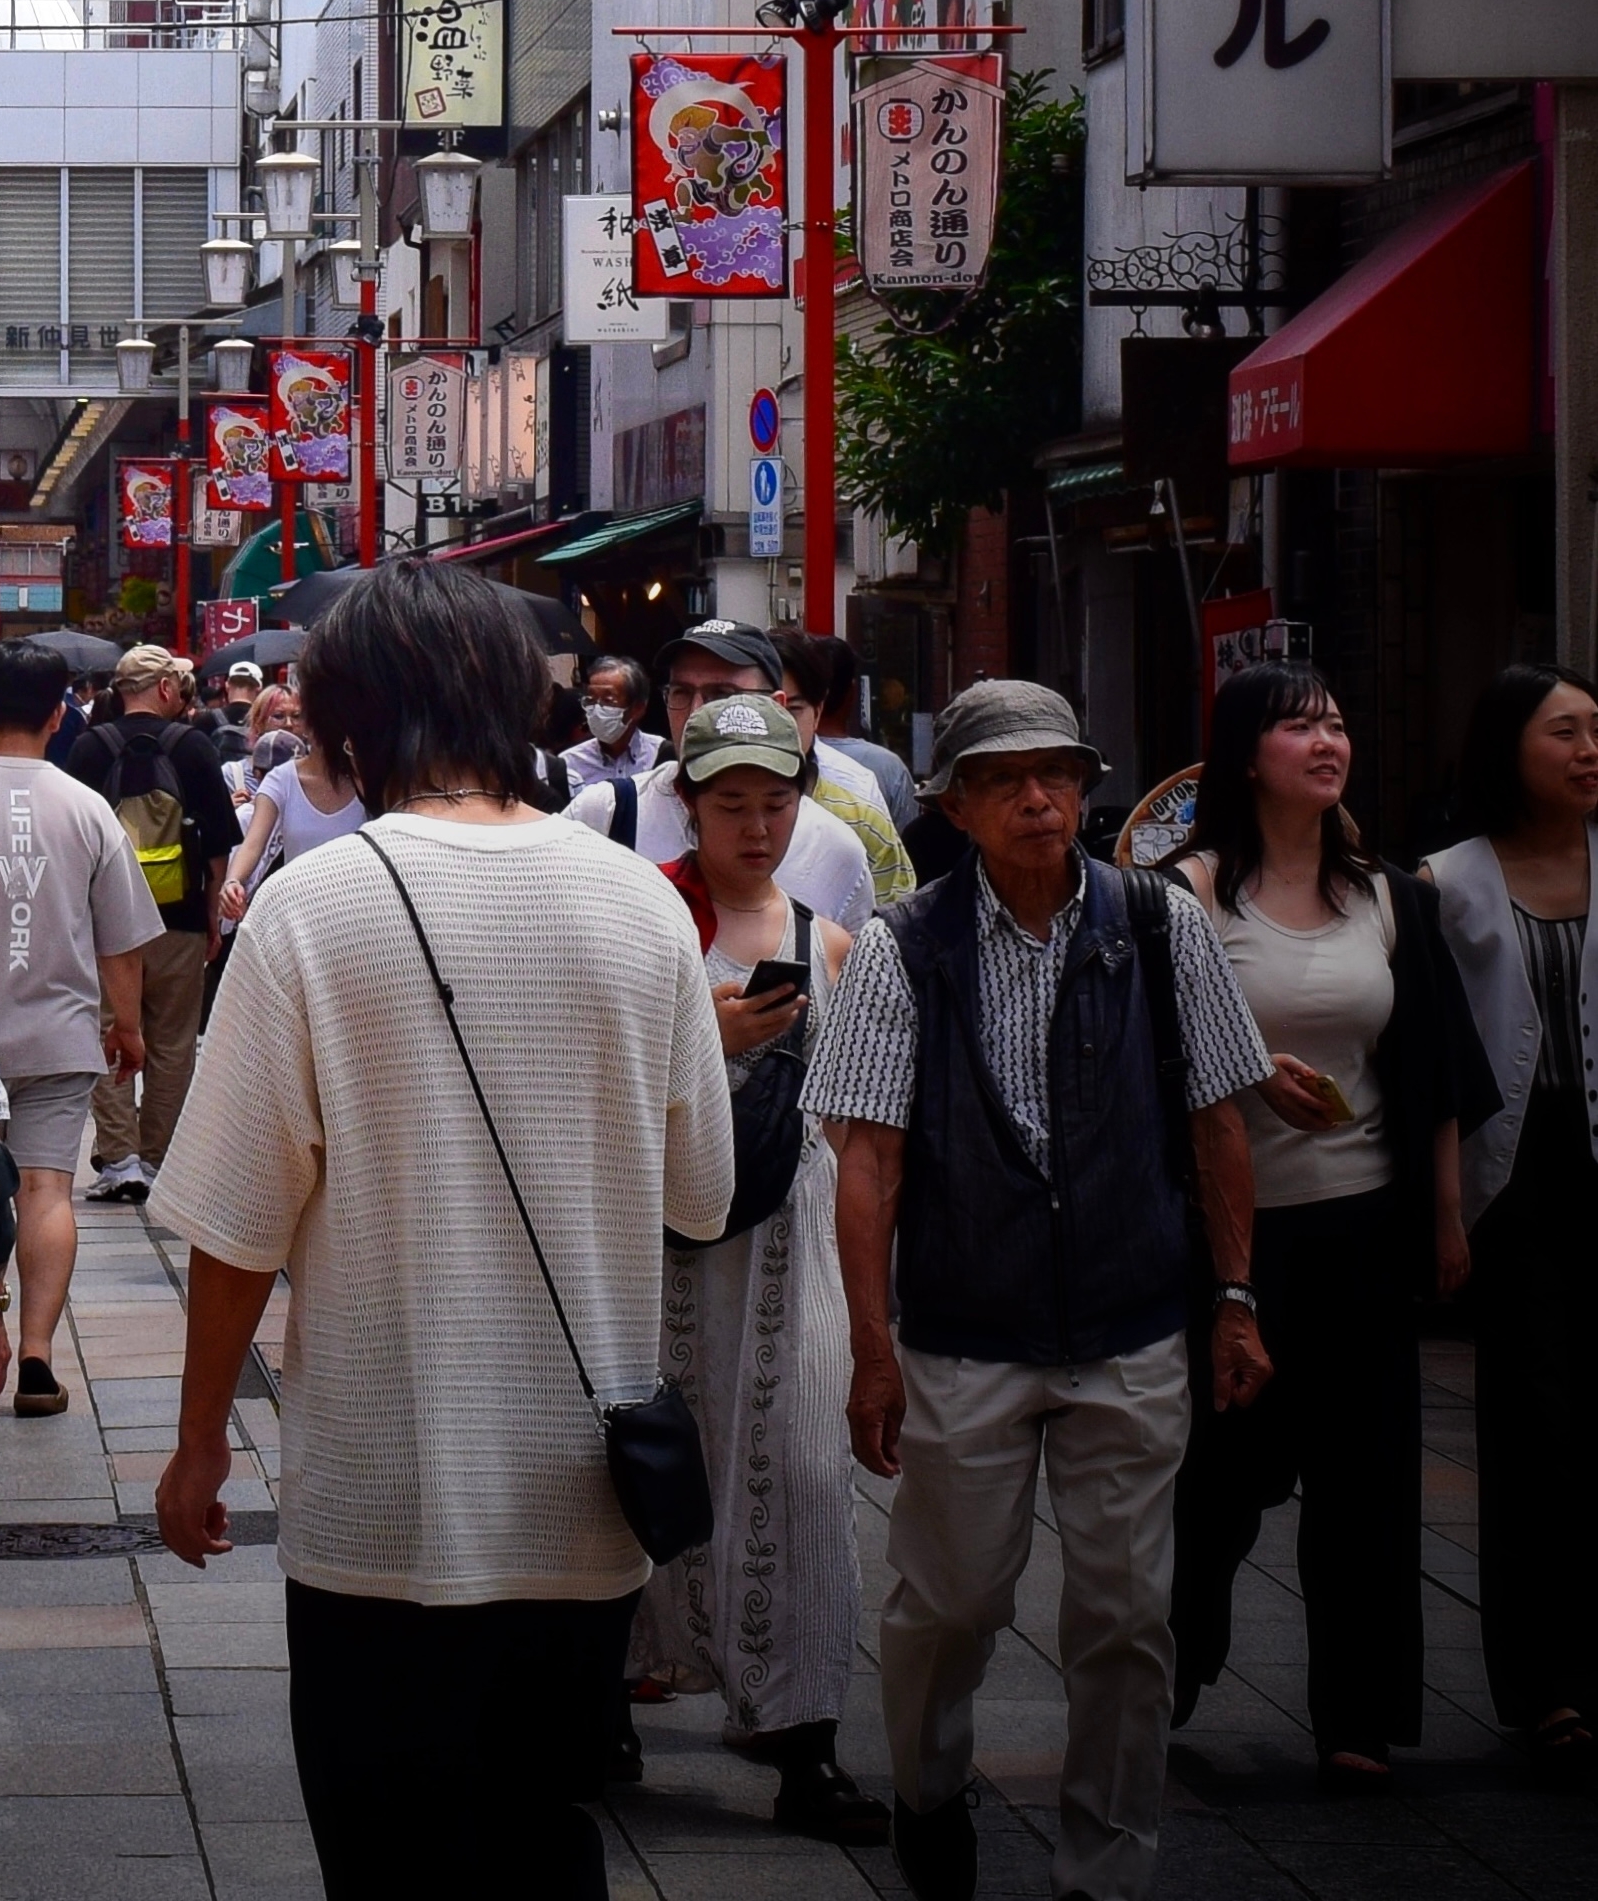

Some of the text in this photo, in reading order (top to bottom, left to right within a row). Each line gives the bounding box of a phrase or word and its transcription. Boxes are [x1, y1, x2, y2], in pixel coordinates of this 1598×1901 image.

[890, 151, 914, 267] メトロ商店会
[931, 88, 969, 269] かんのん通り
[648, 208, 684, 269] 浅草
[6, 325, 120, 349] 新仲見世
[426, 371, 447, 467] かんのん通り
[10, 789, 32, 853] LIFE
